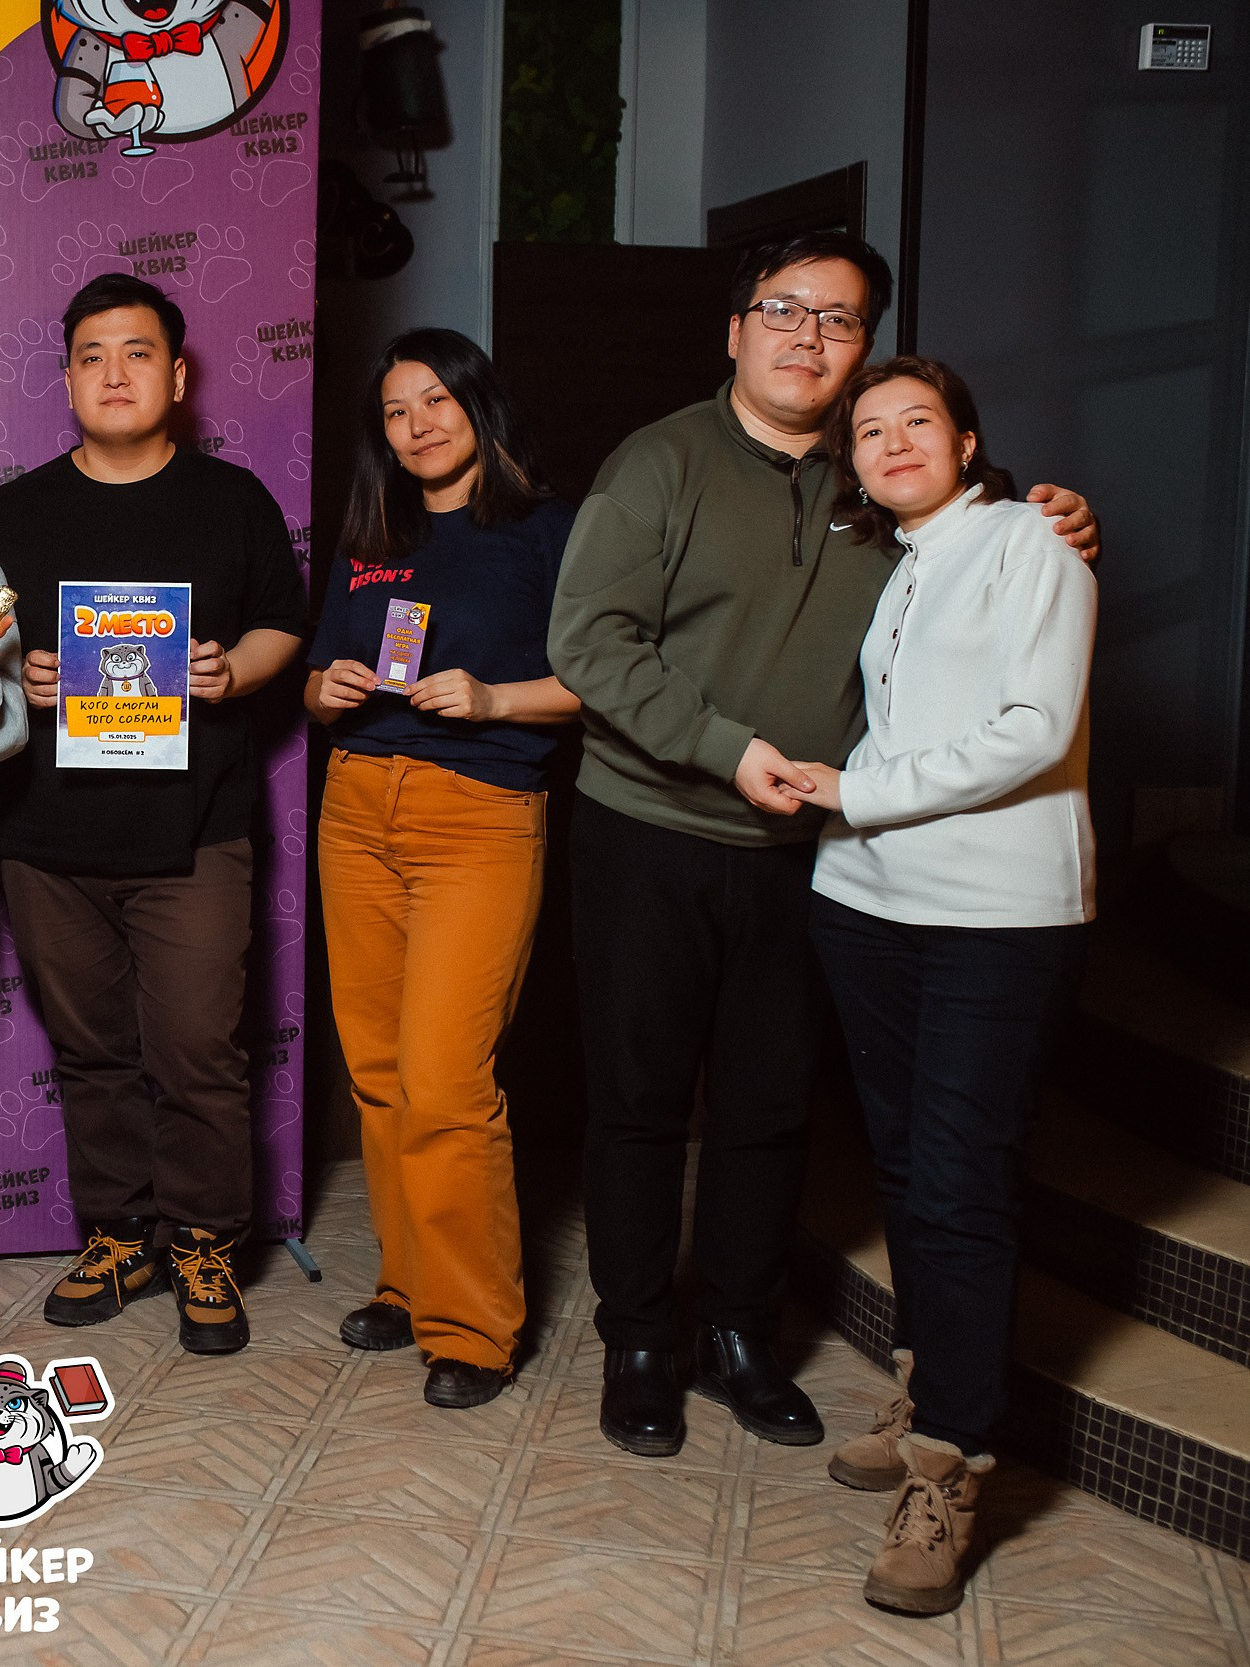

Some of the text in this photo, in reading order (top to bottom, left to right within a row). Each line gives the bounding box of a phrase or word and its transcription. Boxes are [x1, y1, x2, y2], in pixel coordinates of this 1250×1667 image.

[230, 112, 309, 136] ШЕЙКЕР
[28, 137, 109, 162] ШЕЙКЕР
[243, 135, 299, 158] КВИЗ
[44, 161, 98, 183] КВИЗ
[118, 231, 198, 257] ШЕЙКЕР
[133, 256, 187, 278] КВИЗ
[257, 318, 313, 343] ШЕЙК
[271, 342, 312, 363] КВИ
[94, 594, 157, 604] ШЕЙКЕР КВИЗ
[75, 607, 174, 636] 2 МЕСТО
[396, 627, 413, 635] ОДНА
[86, 714, 172, 724] ТОГО СОБРАЛИ
